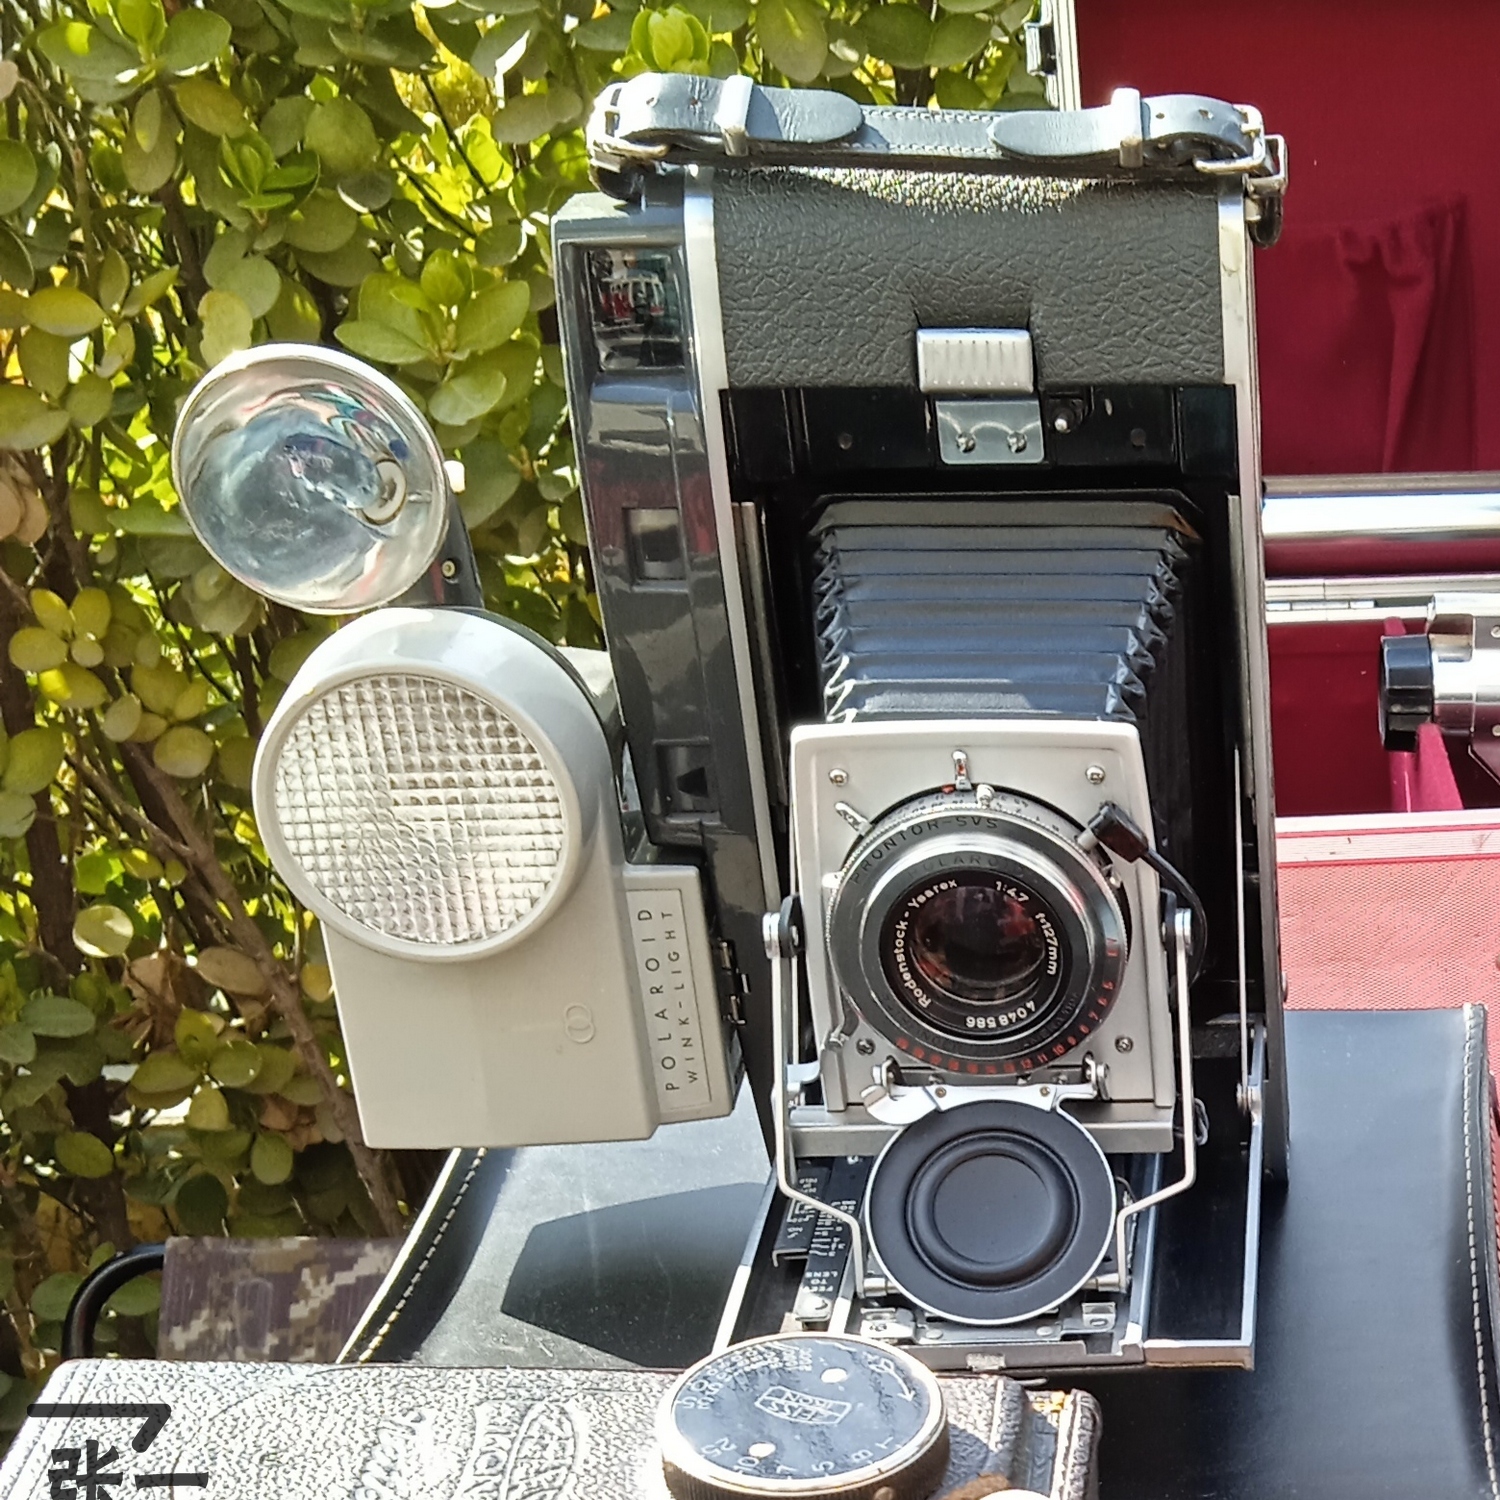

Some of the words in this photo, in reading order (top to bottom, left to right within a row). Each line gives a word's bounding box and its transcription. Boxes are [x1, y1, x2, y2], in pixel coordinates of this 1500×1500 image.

[850, 816, 998, 884] PRONTOR-SVS
[907, 879, 958, 909] Ysarex
[893, 919, 932, 1009] Rodenstock
[637, 909, 681, 1091] POLAROID
[661, 911, 699, 1084] WINK-LIGHT
[689, 1379, 724, 1395] 50
[680, 1396, 715, 1410] 35
[701, 1437, 737, 1458] 25
[851, 1448, 874, 1463] B
[733, 1457, 760, 1473] 10
[776, 1463, 797, 1475] 7
[812, 1461, 836, 1473] 5
